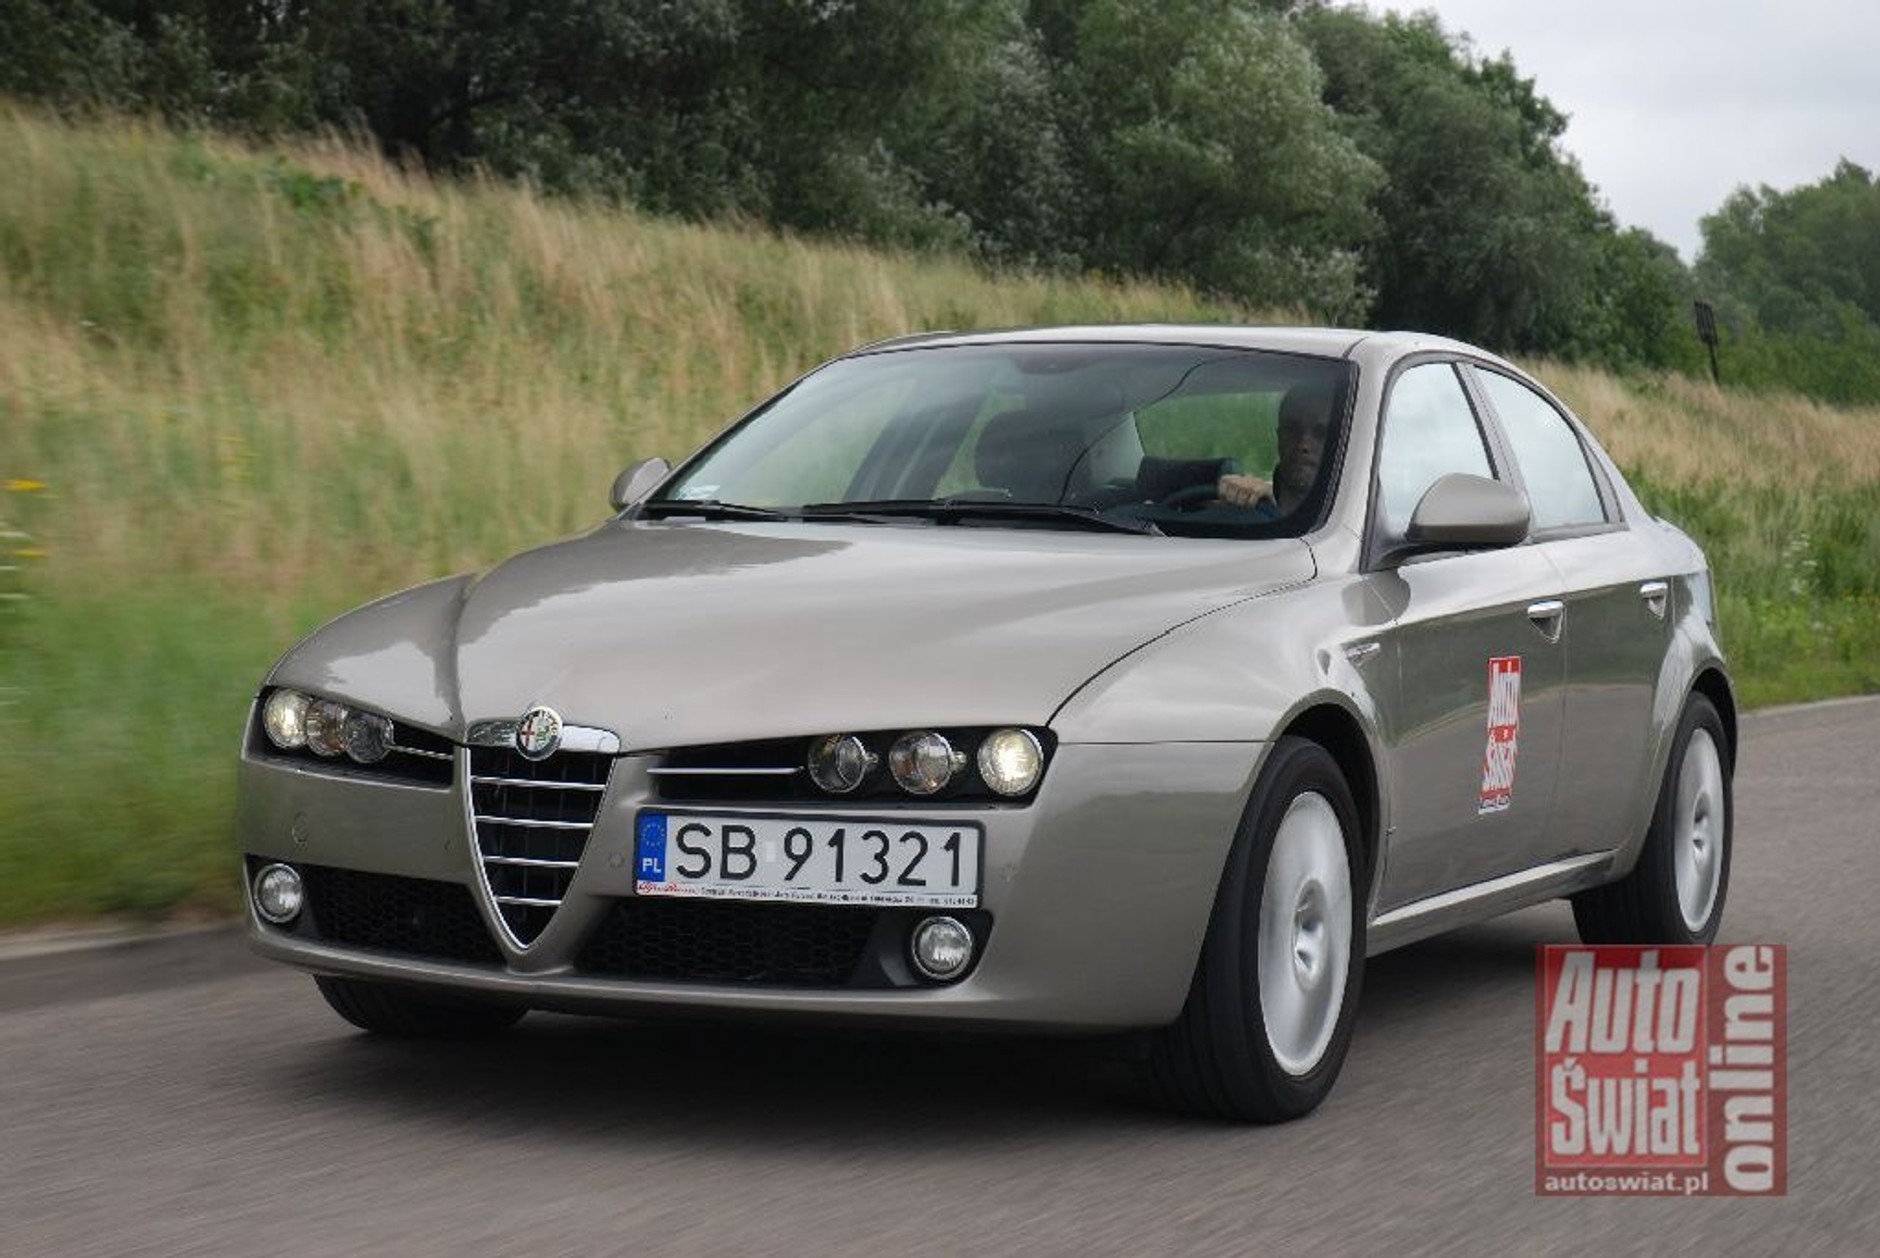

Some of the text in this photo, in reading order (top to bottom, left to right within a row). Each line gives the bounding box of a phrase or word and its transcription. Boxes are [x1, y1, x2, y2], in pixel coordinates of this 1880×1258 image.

[642, 857, 662, 874] PL
[676, 823, 961, 887] SB 91321
